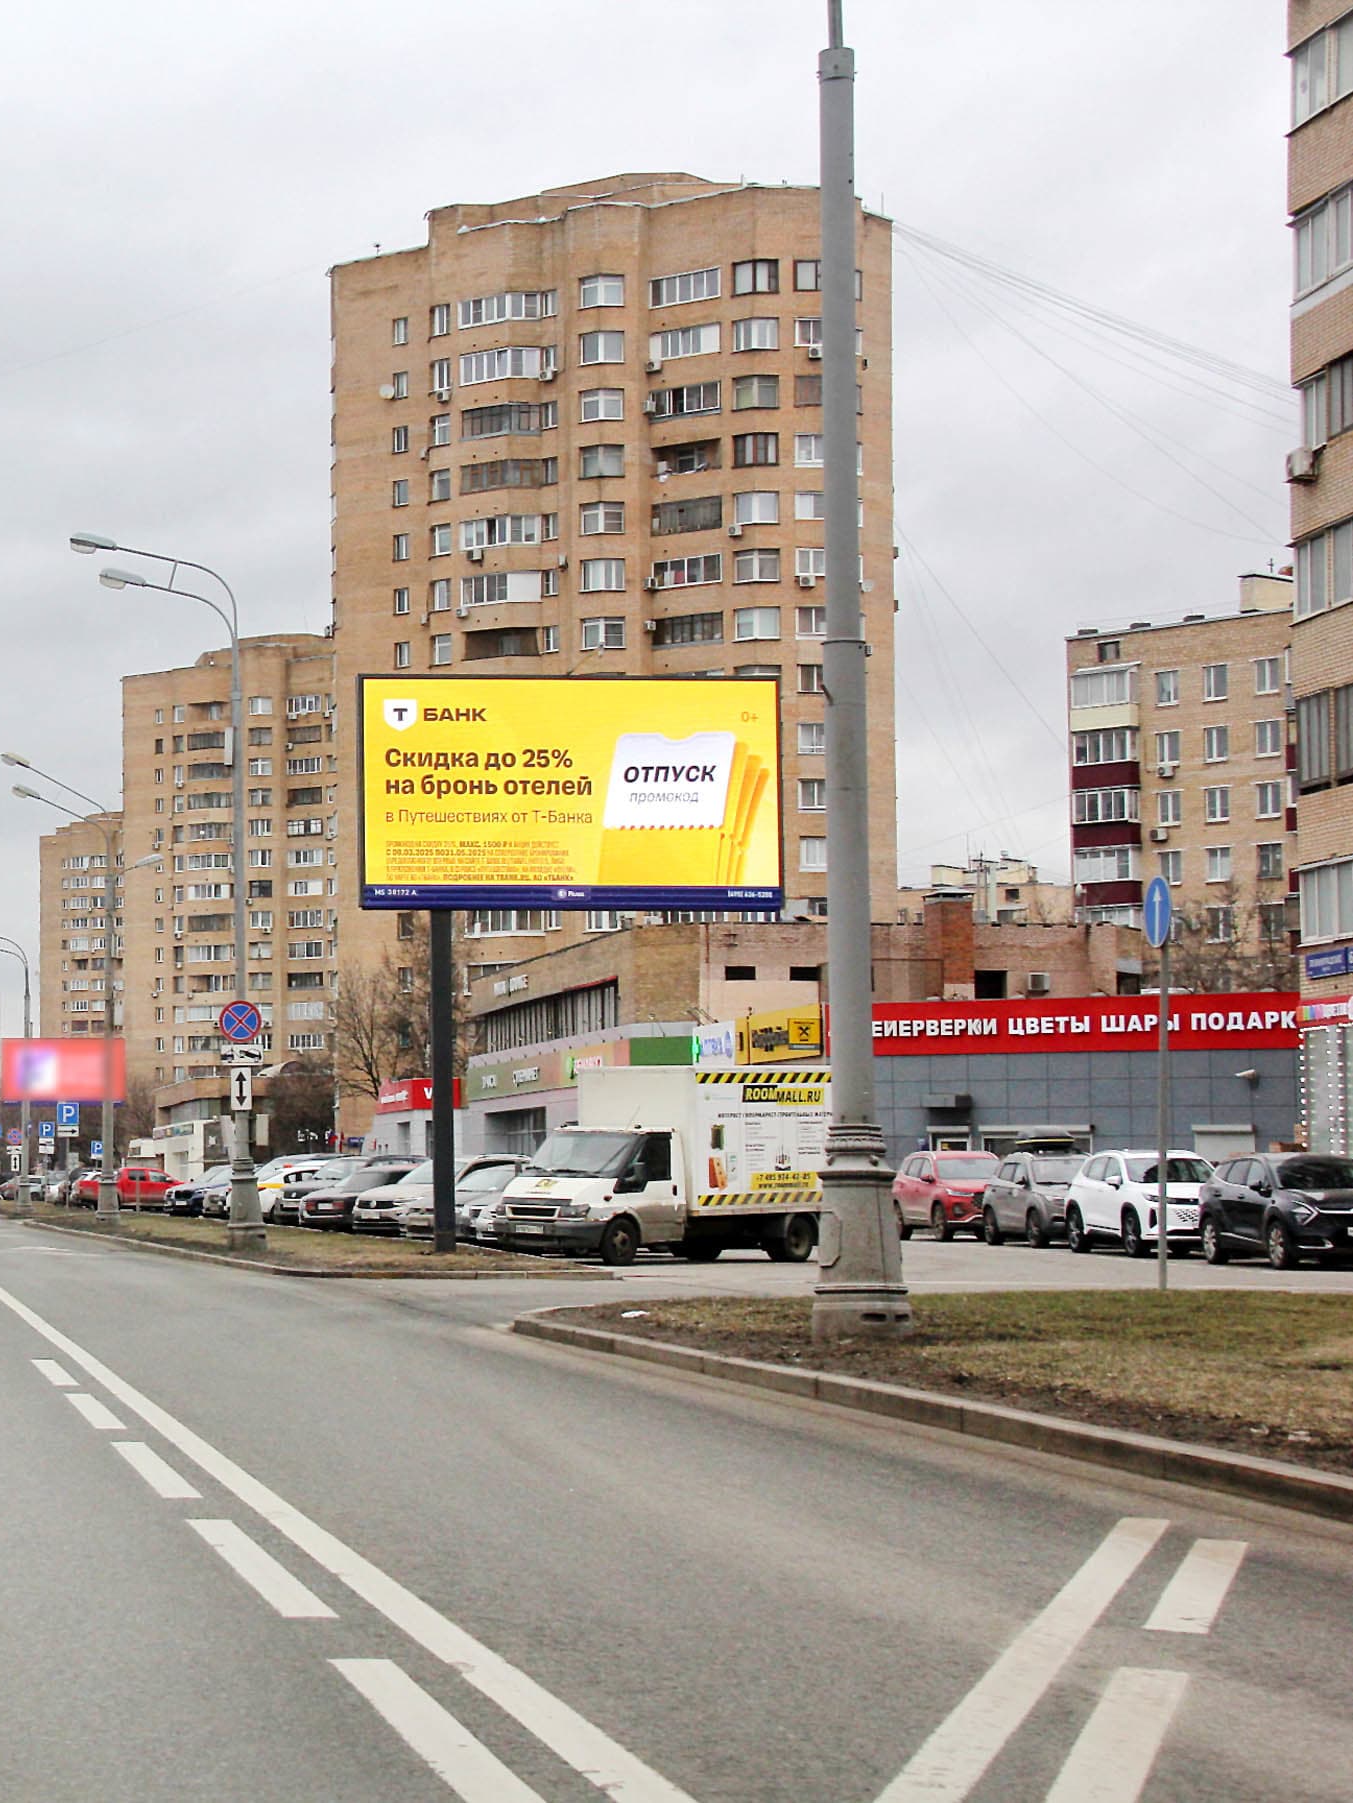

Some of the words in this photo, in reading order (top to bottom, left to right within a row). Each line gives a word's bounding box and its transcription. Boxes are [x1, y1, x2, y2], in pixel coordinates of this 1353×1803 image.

[393, 708, 408, 722] Т
[423, 708, 487, 722] БАНК
[741, 711, 759, 723] 0+
[385, 748, 479, 771] Скидка
[484, 752, 517, 771] до
[522, 749, 573, 768] 25%
[623, 765, 717, 783] ОТПУСК
[385, 778, 415, 795] на
[421, 774, 498, 799] бронь
[503, 776, 592, 796] отелей
[629, 791, 700, 805] промокод
[385, 812, 394, 823] в
[399, 809, 508, 826] Путешествиях
[511, 812, 528, 823] от
[533, 810, 593, 824] Т-Банка
[871, 1018, 997, 1037] ЕЙЕРВЕРКИ
[1008, 1016, 1090, 1036] ЦВЕТЫ
[1101, 1014, 1180, 1033] ШАРЫ
[1191, 1011, 1297, 1031] ПОДАРК
